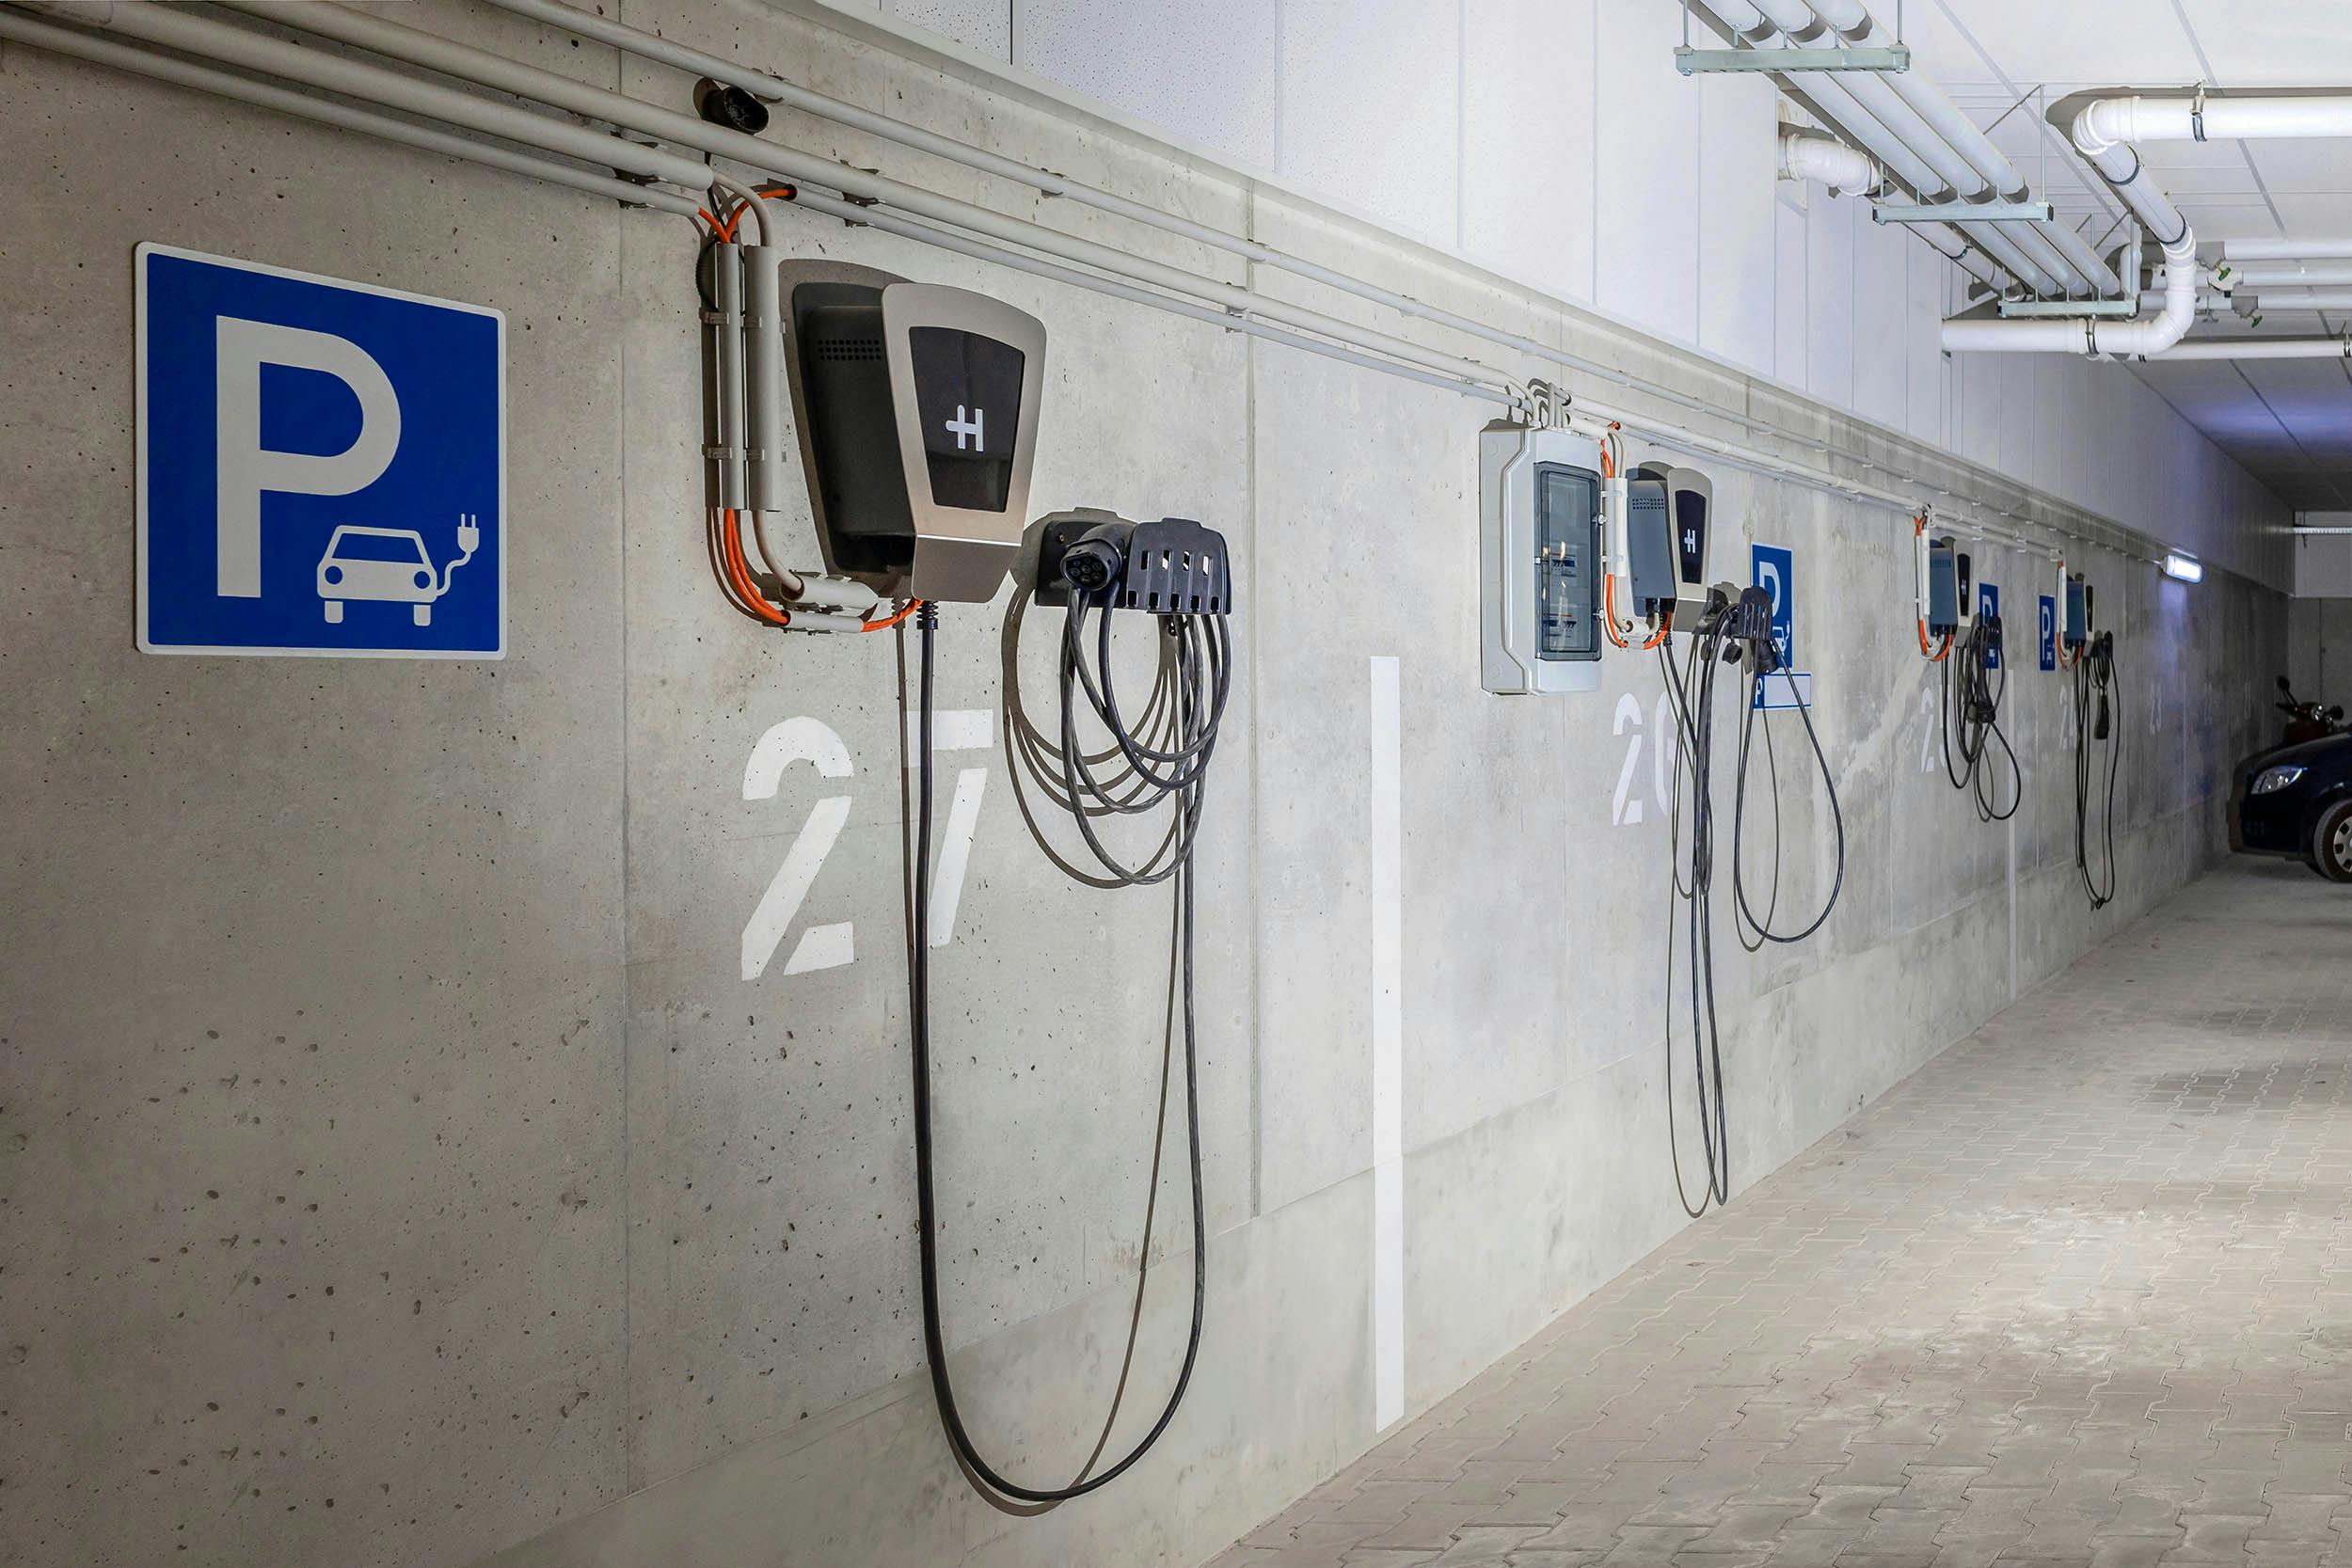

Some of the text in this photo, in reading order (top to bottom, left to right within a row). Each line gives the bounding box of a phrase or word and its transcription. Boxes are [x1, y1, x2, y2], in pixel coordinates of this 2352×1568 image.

[216, 315, 402, 598] P
[1759, 562, 1781, 618] P
[2042, 605, 2051, 661] P
[1755, 677, 1763, 705] P
[741, 708, 994, 982] 27
